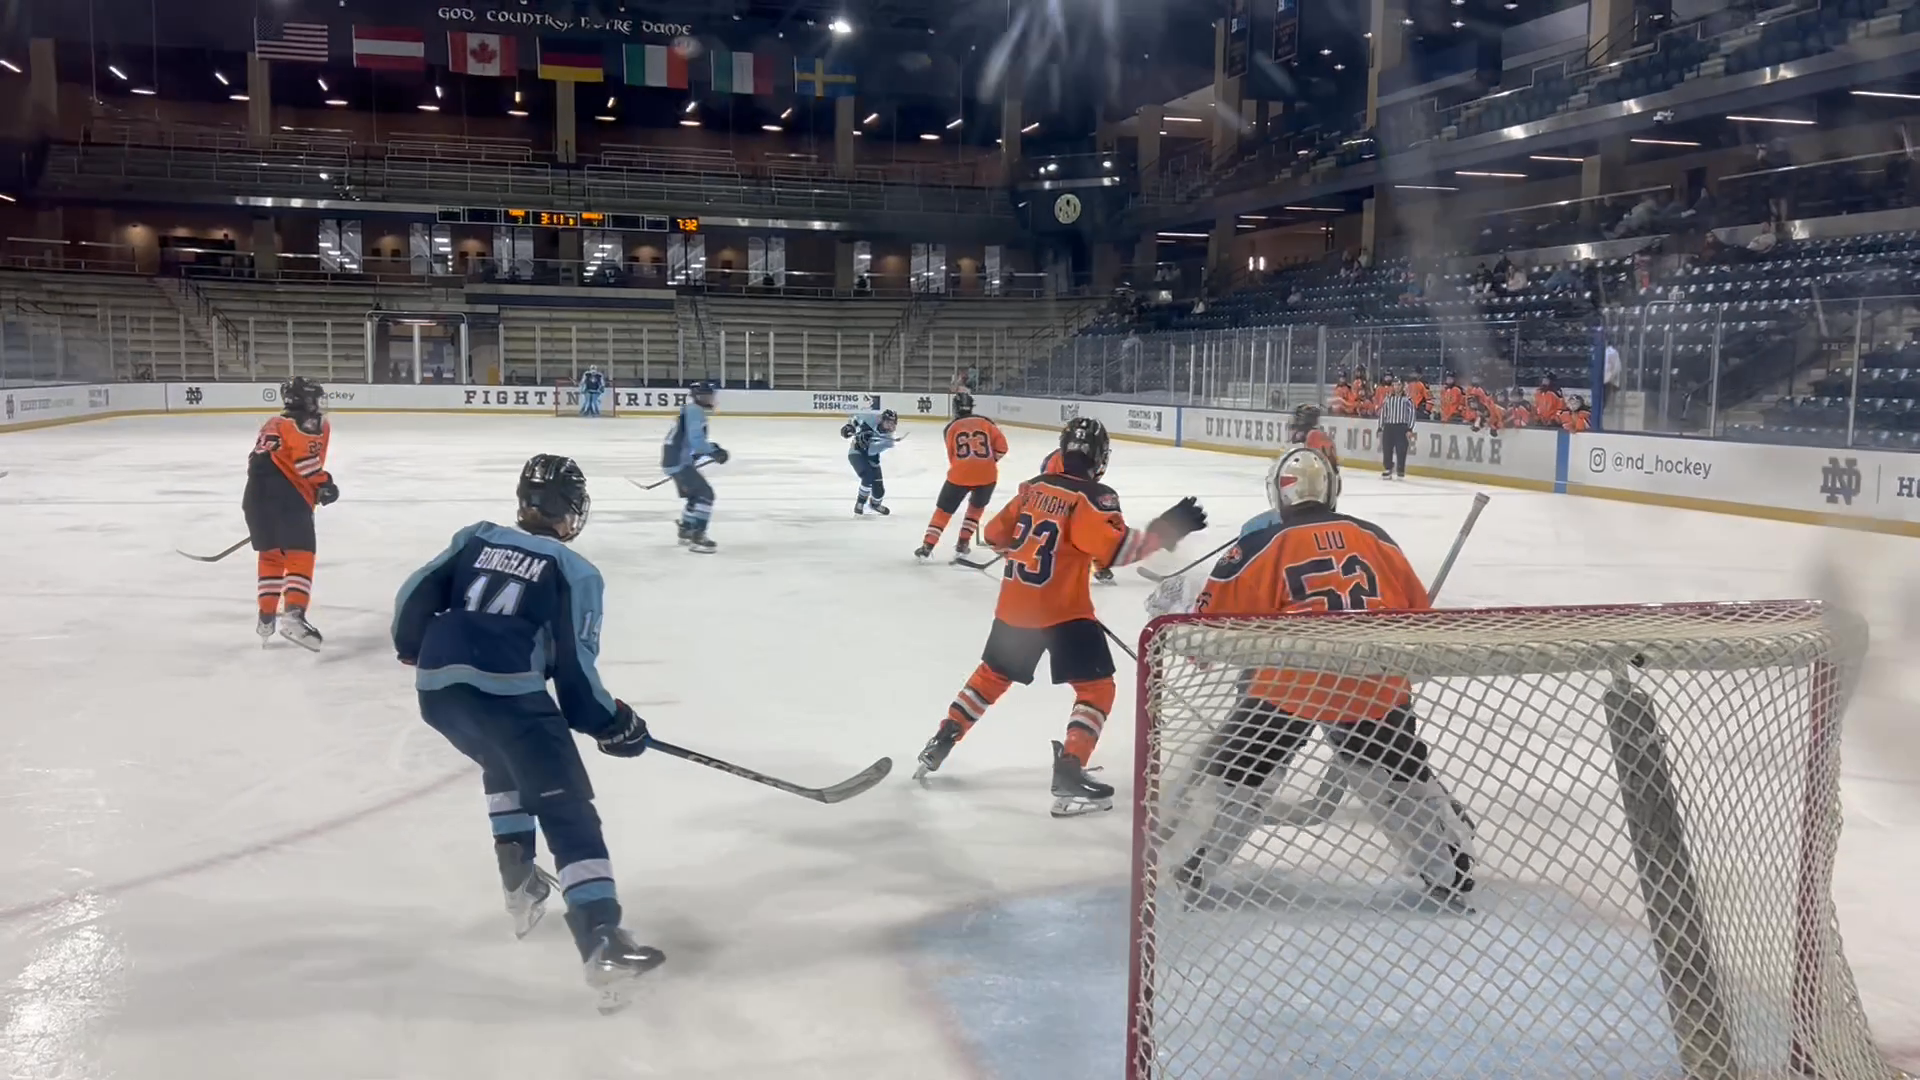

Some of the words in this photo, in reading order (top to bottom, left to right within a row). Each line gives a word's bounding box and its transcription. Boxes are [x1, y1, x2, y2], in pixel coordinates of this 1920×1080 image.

[641, 20, 692, 36] DAME
[677, 219, 698, 231] 7:32
[464, 390, 584, 405] FIGHTIN
[614, 392, 689, 407] IRISH
[813, 394, 859, 402] FIGHTING
[954, 430, 990, 460] 63
[1205, 417, 1294, 443] UNIVERSI
[1346, 427, 1418, 456] NOE
[1429, 433, 1503, 464] DAME
[1612, 452, 1712, 479] @nd_hockey
[1896, 476, 1920, 499] H
[1313, 530, 1345, 551] LIU
[472, 546, 548, 583] BINGHAM
[463, 573, 526, 616] 14
[1284, 553, 1380, 613] 52
